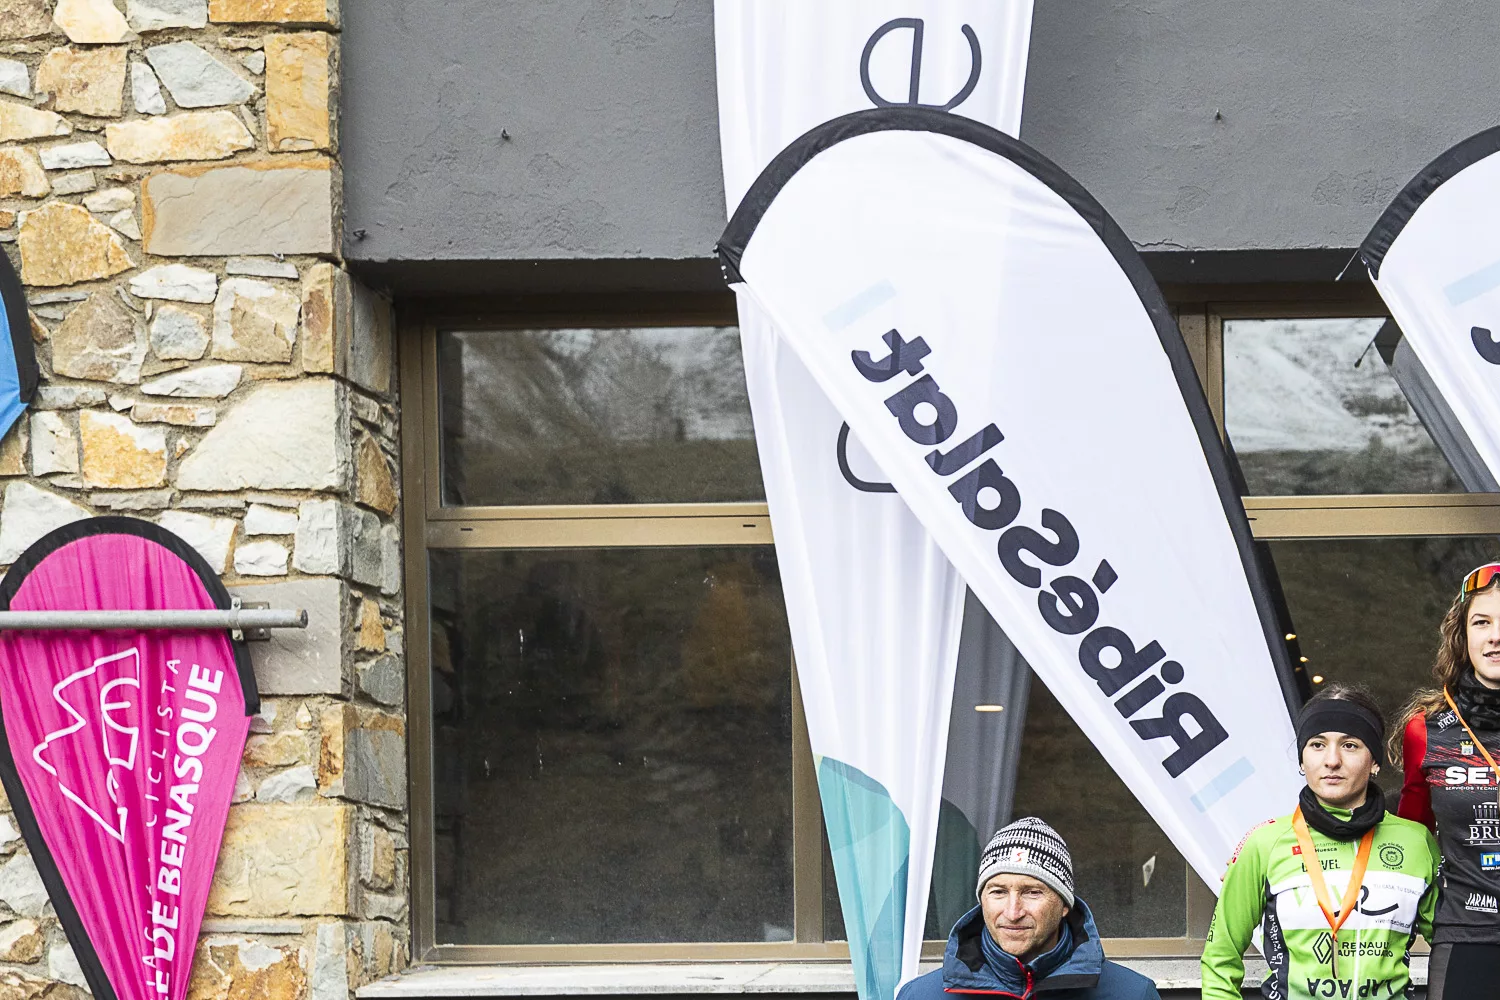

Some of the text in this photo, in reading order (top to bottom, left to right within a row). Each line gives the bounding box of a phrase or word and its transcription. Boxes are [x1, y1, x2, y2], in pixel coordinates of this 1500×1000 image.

[157, 663, 224, 896] BENASQUE
[1465, 892, 1498, 909] JARAMA
[151, 901, 180, 962] DE
